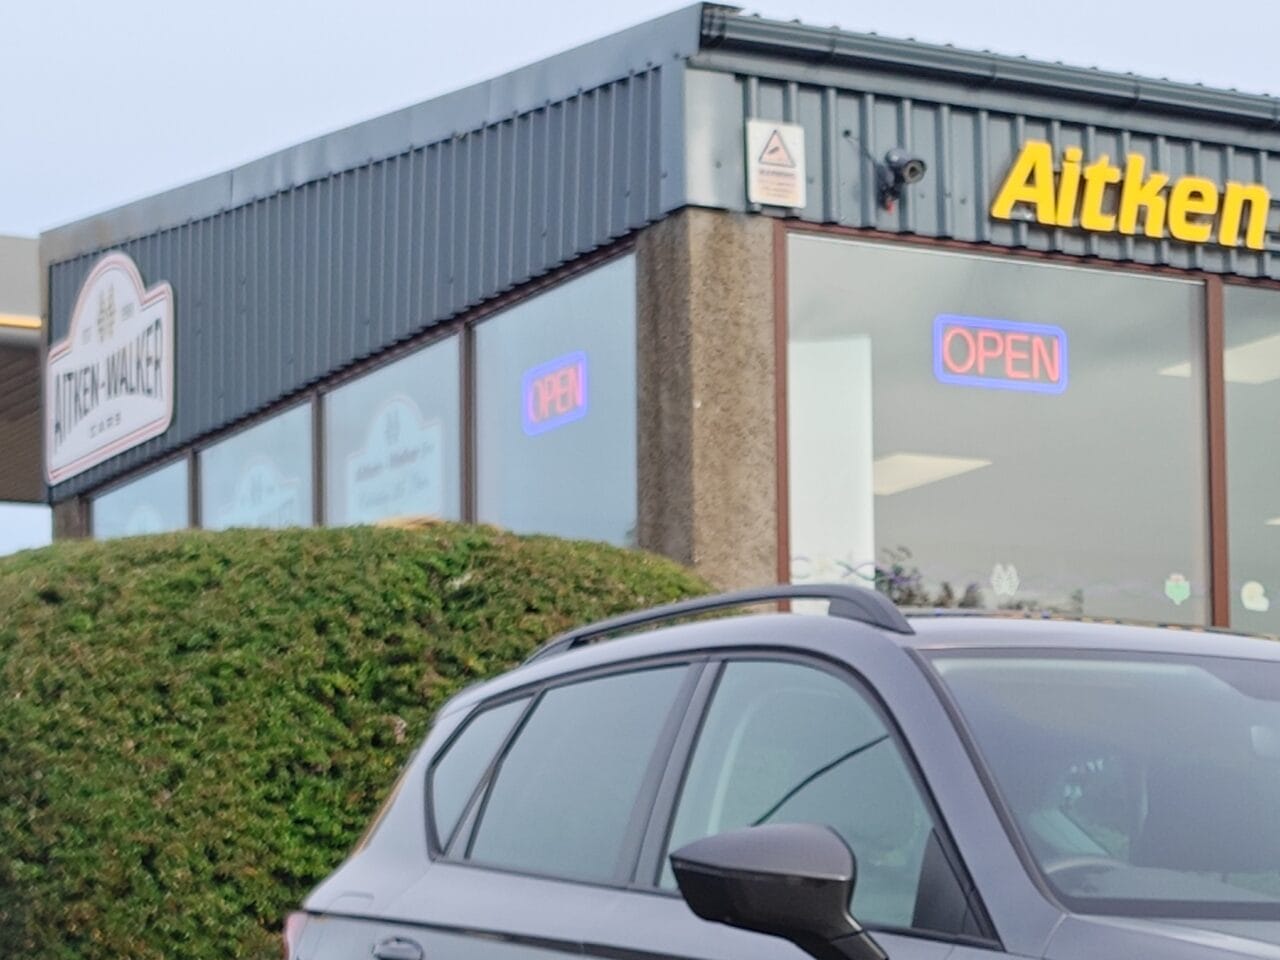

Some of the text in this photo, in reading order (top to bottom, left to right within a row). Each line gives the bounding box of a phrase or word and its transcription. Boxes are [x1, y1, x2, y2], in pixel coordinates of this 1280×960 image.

[993, 144, 1267, 247] Aitken
[54, 317, 165, 455] AITKEN-WALKER
[527, 362, 584, 424] OPEN
[942, 326, 1061, 383] OPEN
